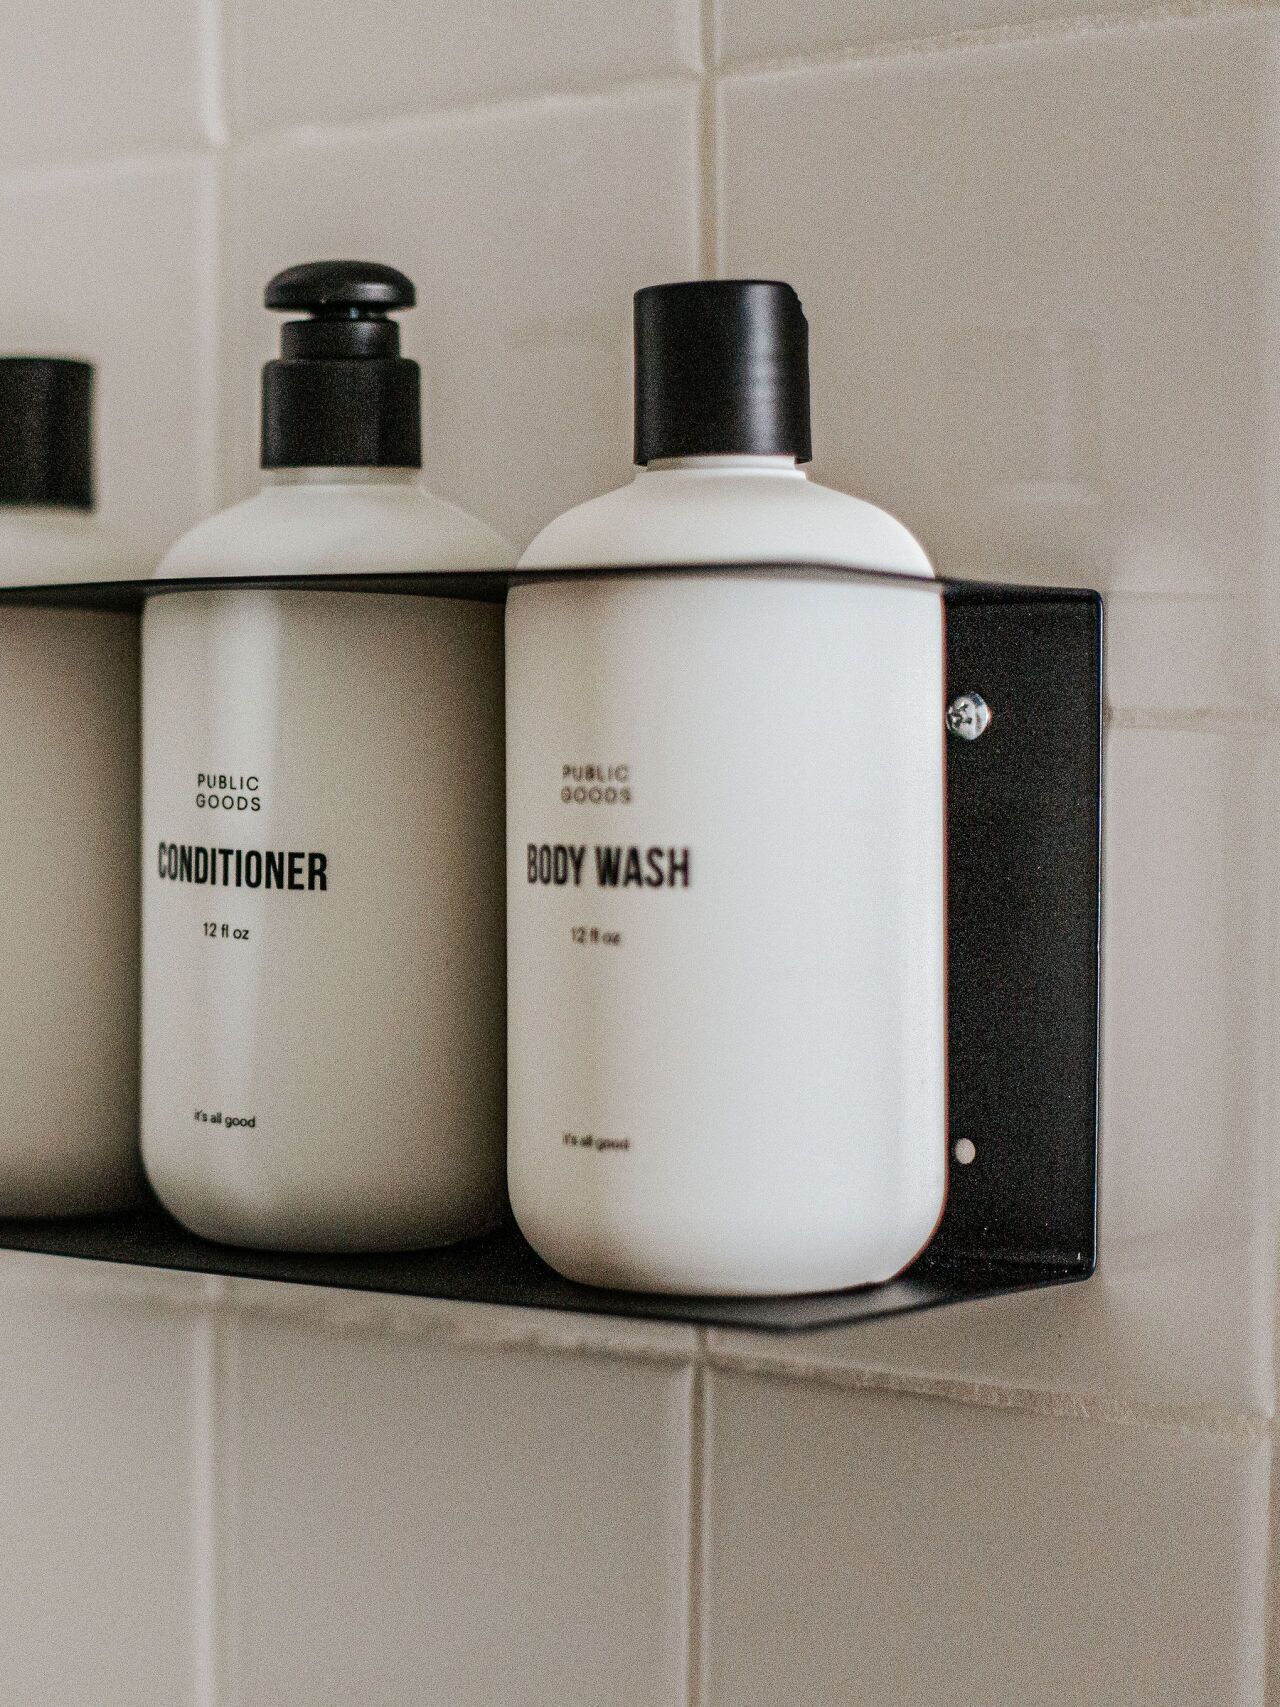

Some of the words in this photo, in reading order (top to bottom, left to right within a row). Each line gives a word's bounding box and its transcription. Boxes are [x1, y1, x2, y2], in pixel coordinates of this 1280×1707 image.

[197, 773, 259, 791] PUBLIC
[562, 764, 629, 782] PUBLIC
[196, 793, 261, 811] GOODS
[561, 786, 632, 804] GOODS
[158, 841, 328, 891] CONDITIONER
[526, 843, 587, 886] BODY
[594, 845, 690, 888] WASH
[203, 922, 217, 937] 12
[221, 923, 229, 938] fl
[233, 928, 250, 940] oz
[224, 1115, 256, 1128] good
